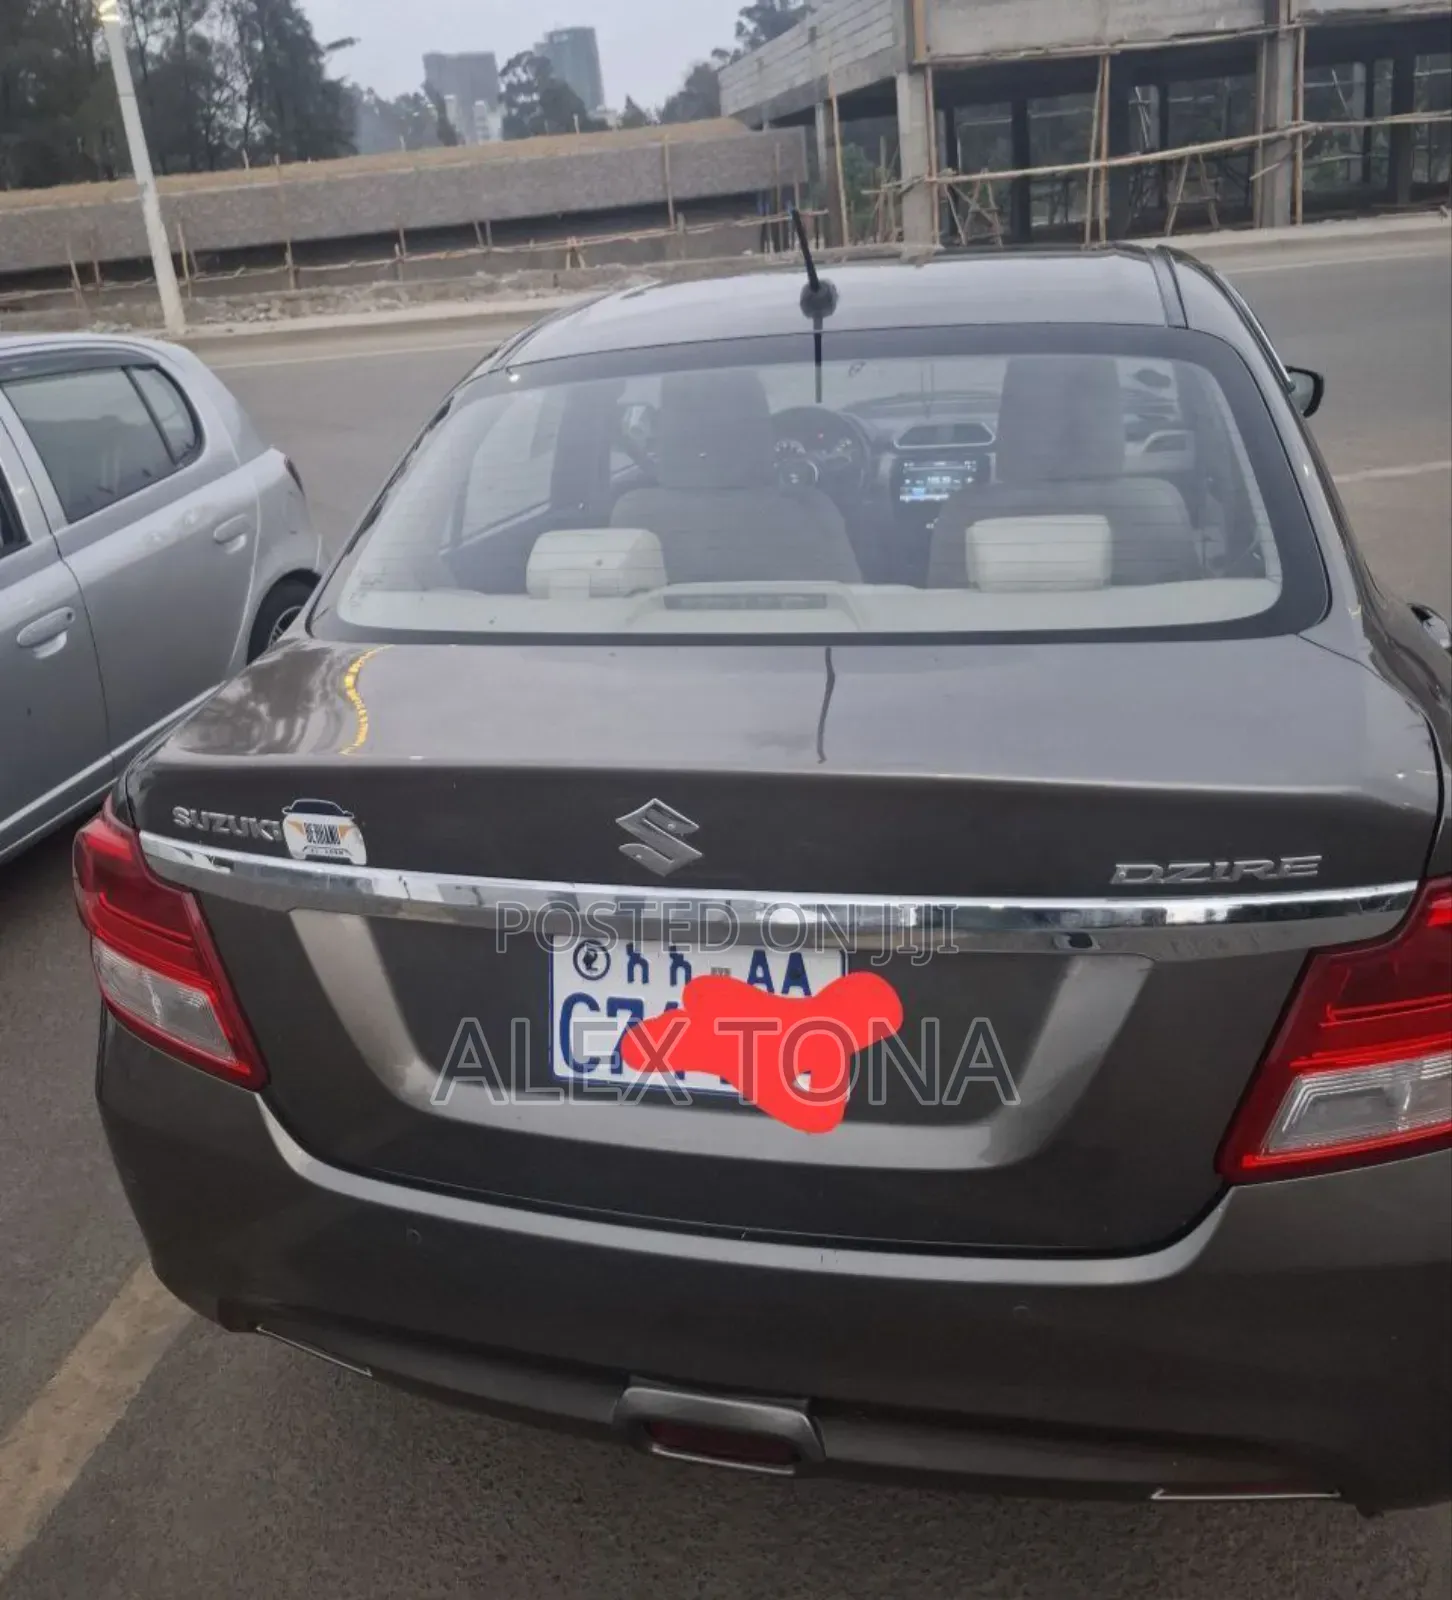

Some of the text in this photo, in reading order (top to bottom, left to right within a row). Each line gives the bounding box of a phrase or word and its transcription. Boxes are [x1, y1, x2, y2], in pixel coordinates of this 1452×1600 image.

[172, 806, 283, 841] SUZUKI
[1110, 855, 1322, 884] DZIRE
[747, 947, 812, 997] AA
